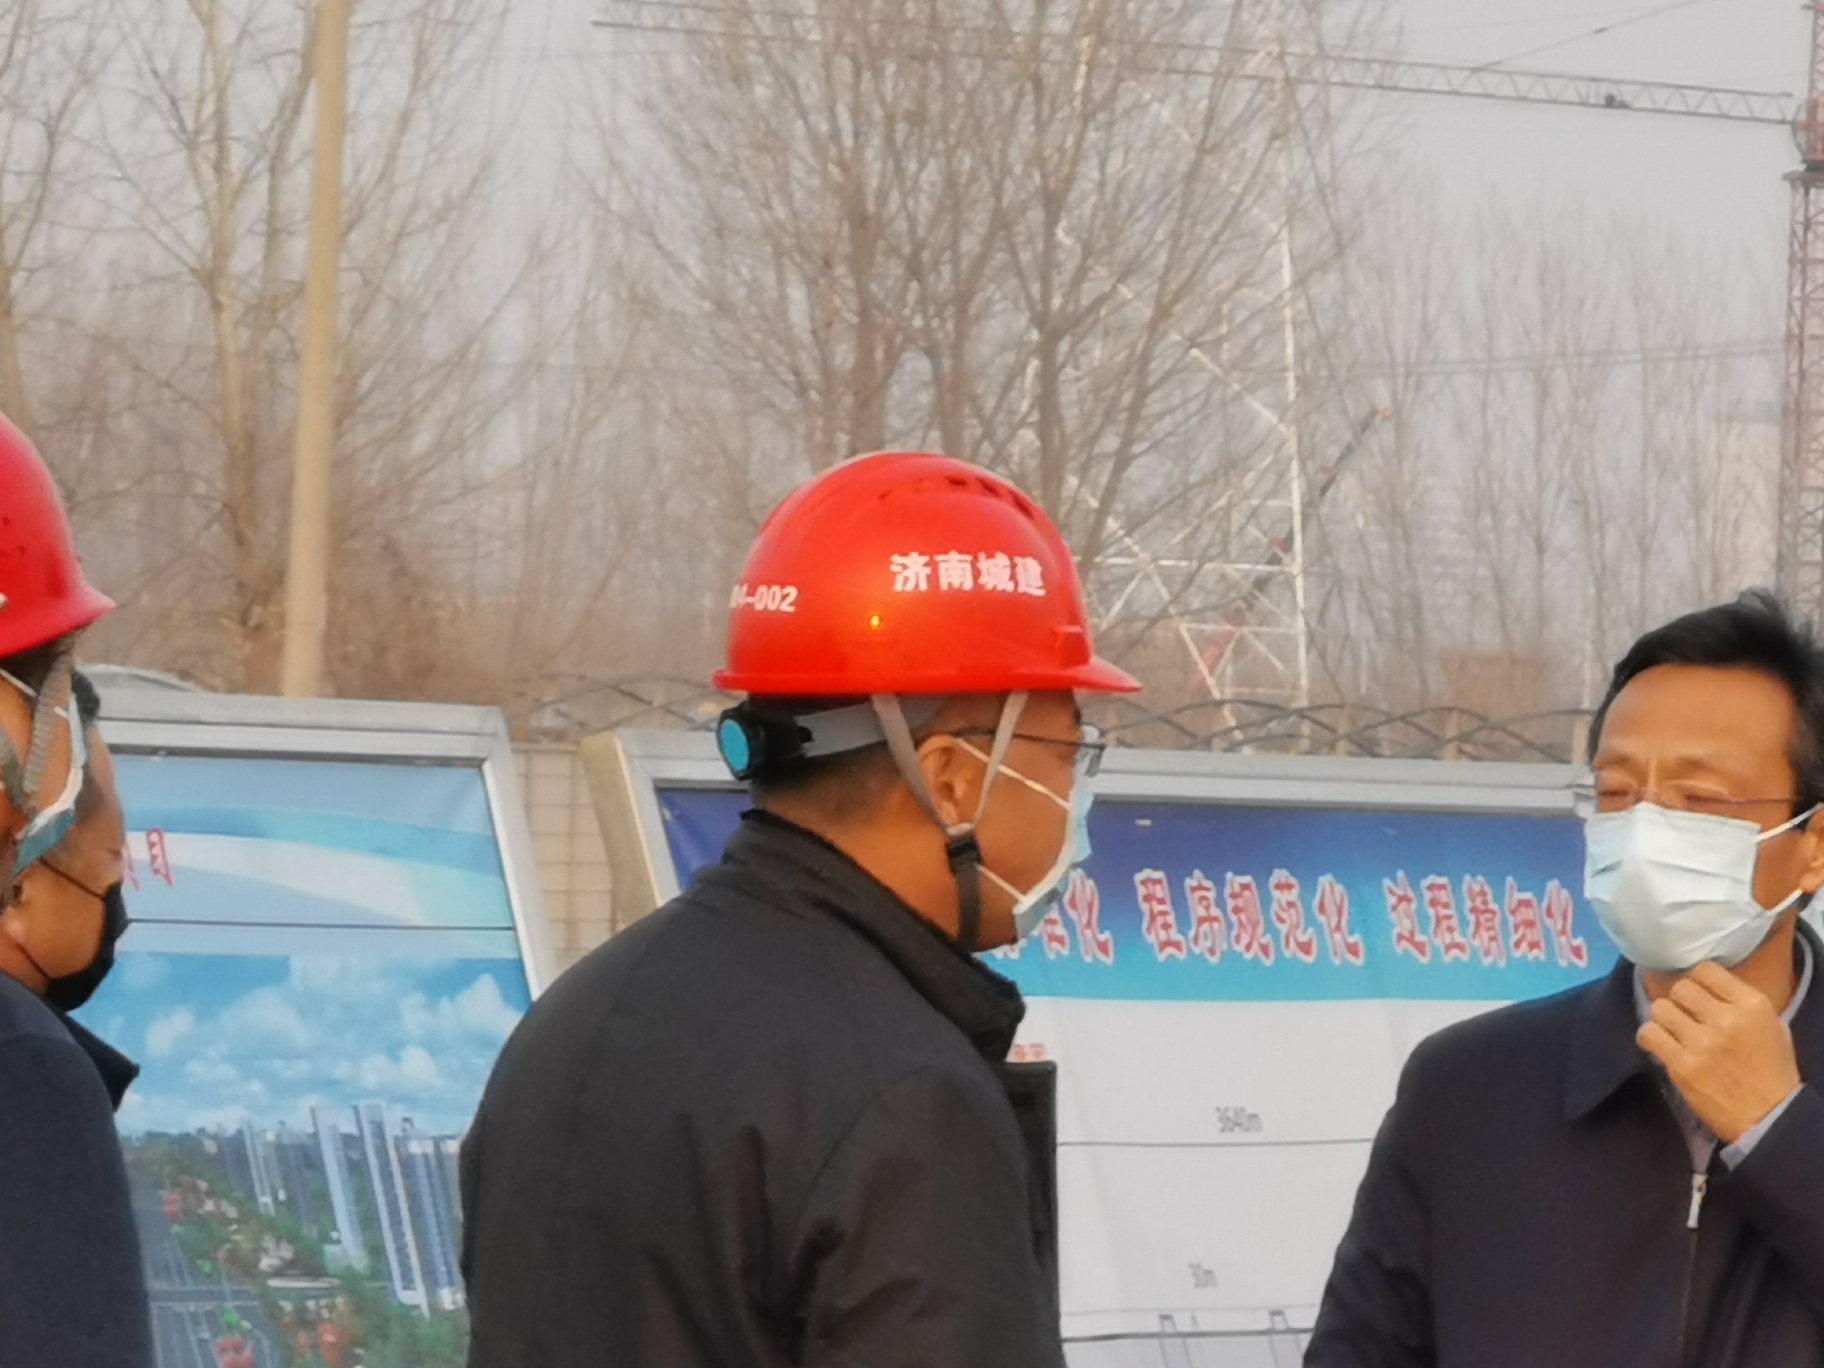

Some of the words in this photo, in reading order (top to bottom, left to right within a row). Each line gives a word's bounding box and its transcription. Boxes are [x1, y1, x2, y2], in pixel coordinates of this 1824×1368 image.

[889, 550, 1047, 597] 济南城建
[1133, 868, 1365, 967] 程序规范化
[1381, 869, 1589, 968] 过程精细化
